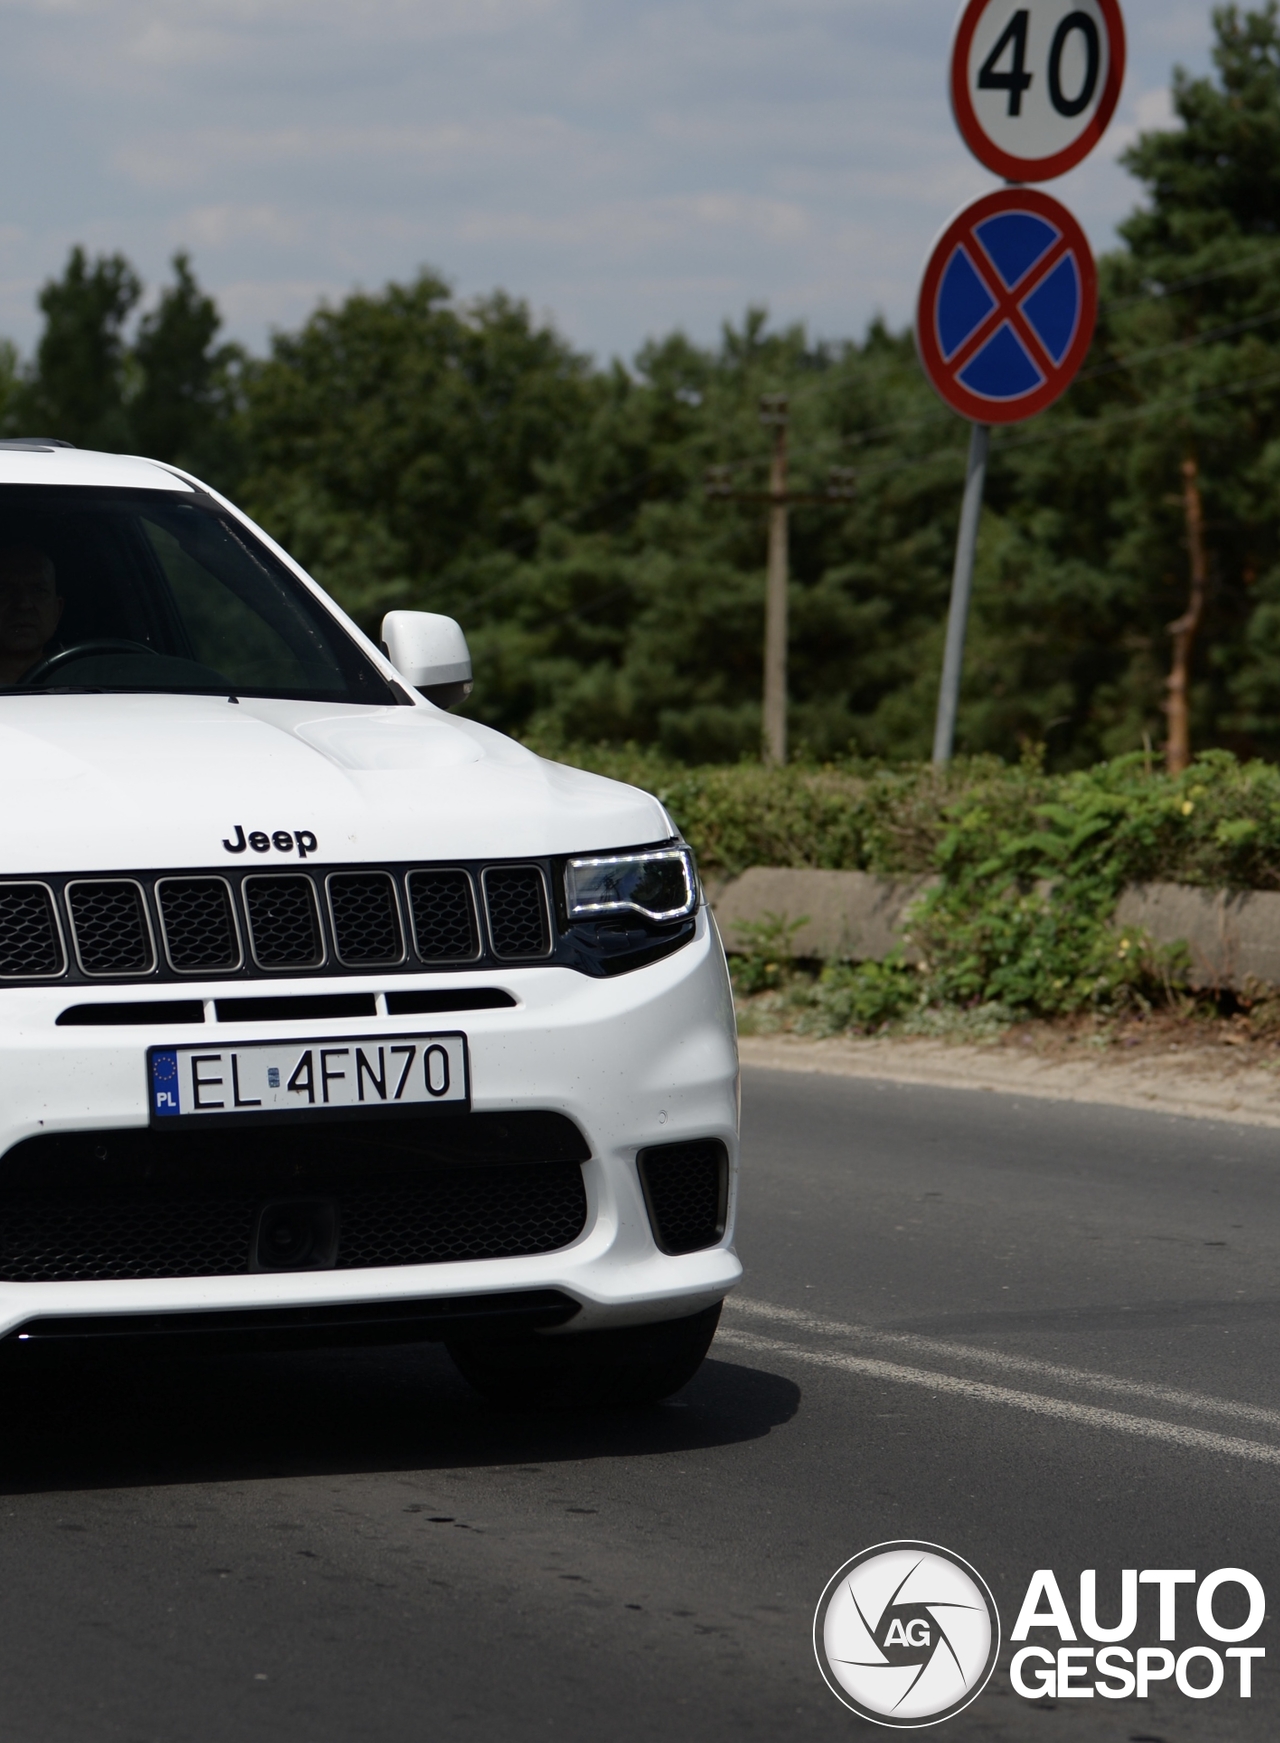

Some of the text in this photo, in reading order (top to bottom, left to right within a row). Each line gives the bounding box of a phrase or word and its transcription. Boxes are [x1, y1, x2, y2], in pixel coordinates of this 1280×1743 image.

[977, 9, 1100, 118] 40
[221, 825, 318, 858] Jeep
[156, 1092, 177, 1108] PL
[190, 1043, 451, 1110] EL 4FN70
